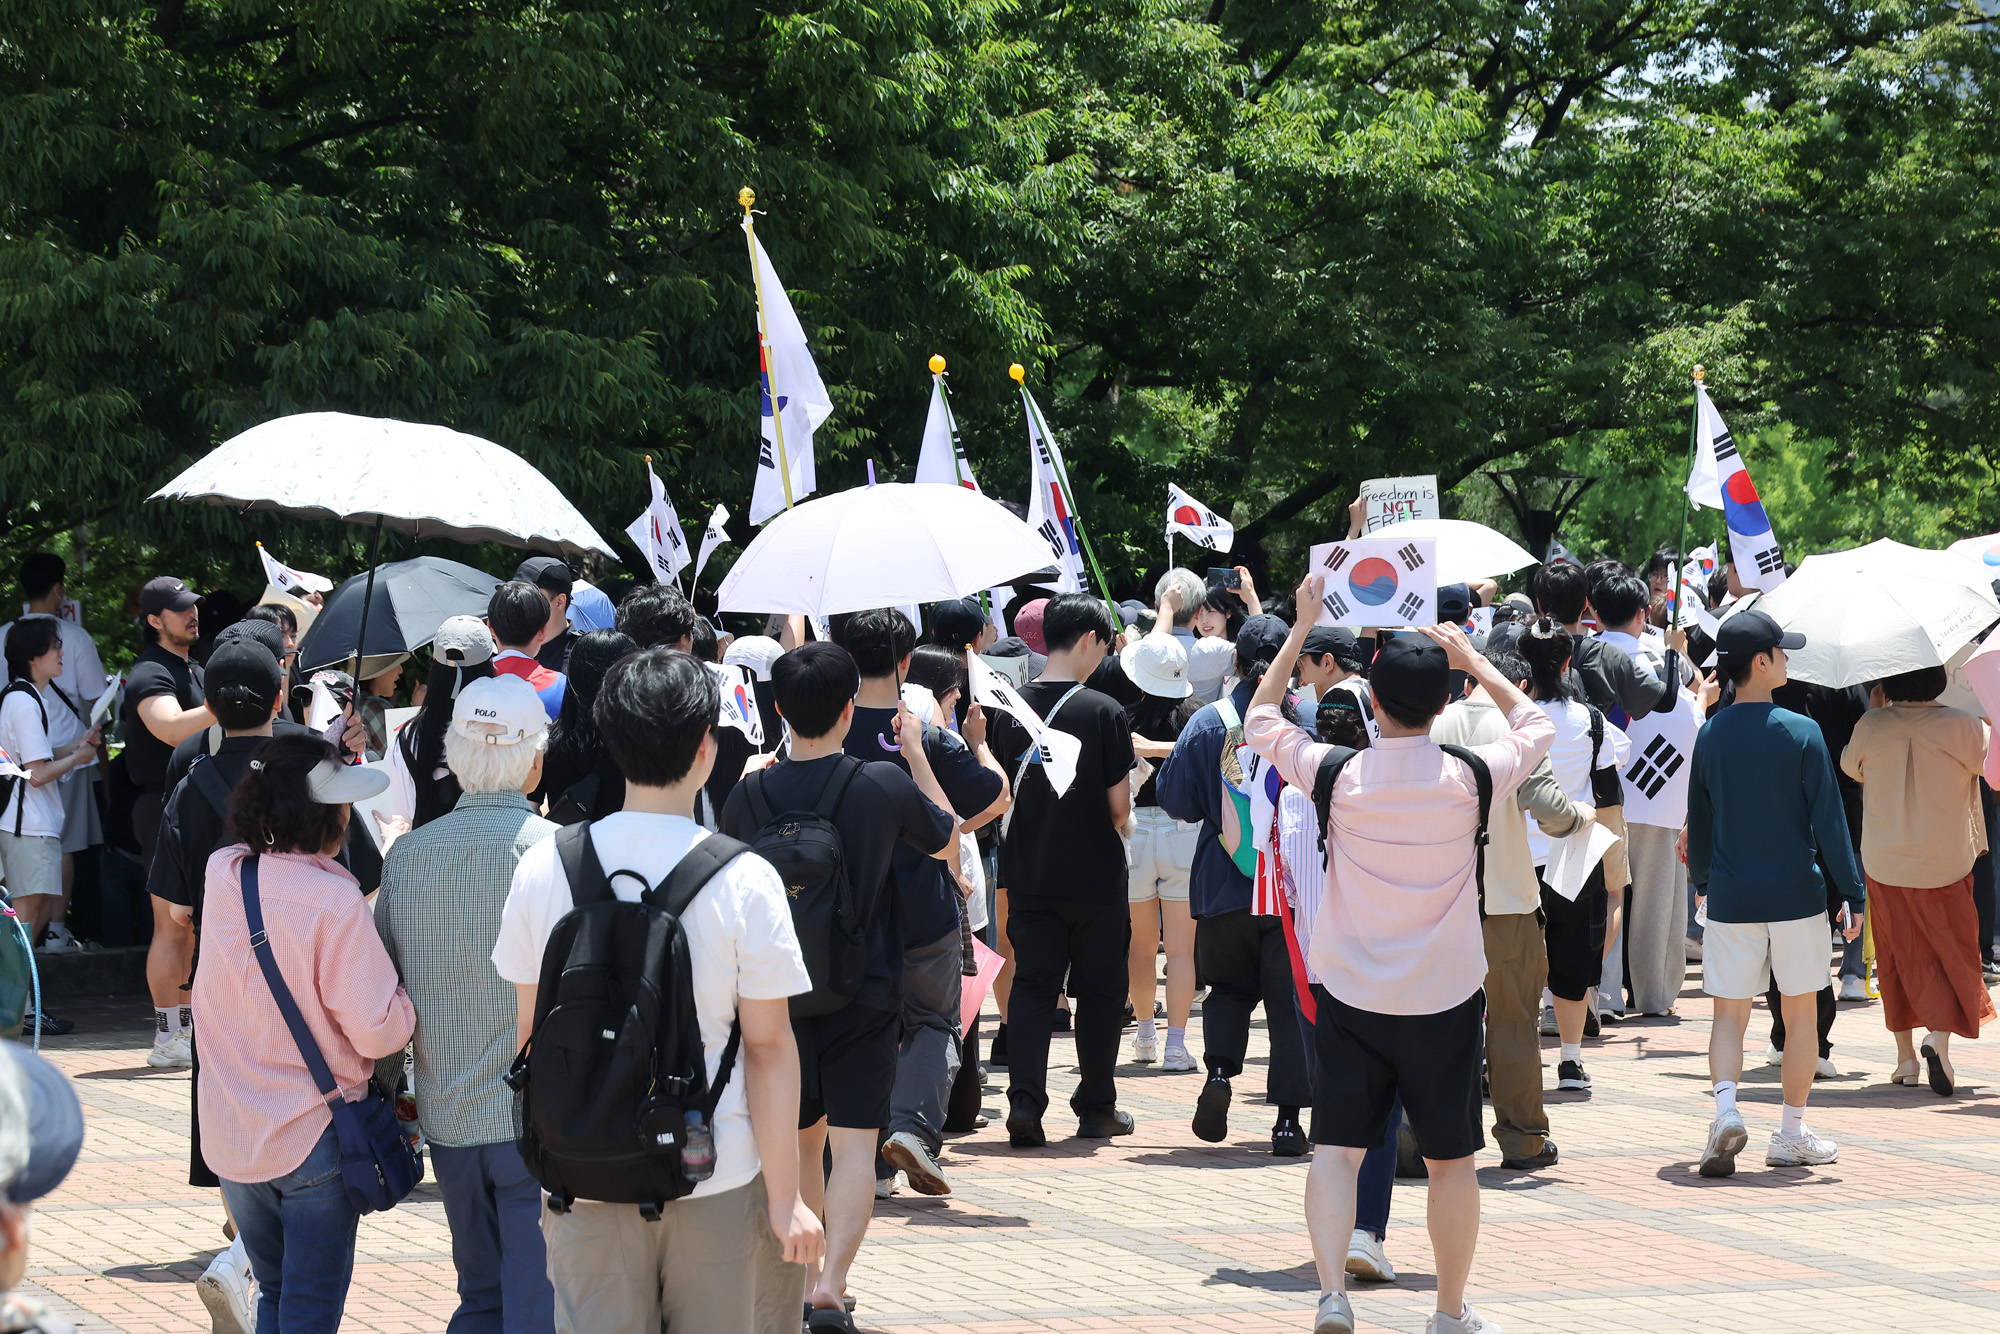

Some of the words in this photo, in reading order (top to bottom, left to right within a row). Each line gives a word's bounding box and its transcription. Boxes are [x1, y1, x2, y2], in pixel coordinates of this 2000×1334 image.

[1360, 484, 1418, 502] Freedom
[1422, 486, 1435, 500] is
[1383, 500, 1415, 515] NOT
[474, 708, 497, 718] POLO
[662, 1132, 675, 1144] NBA
